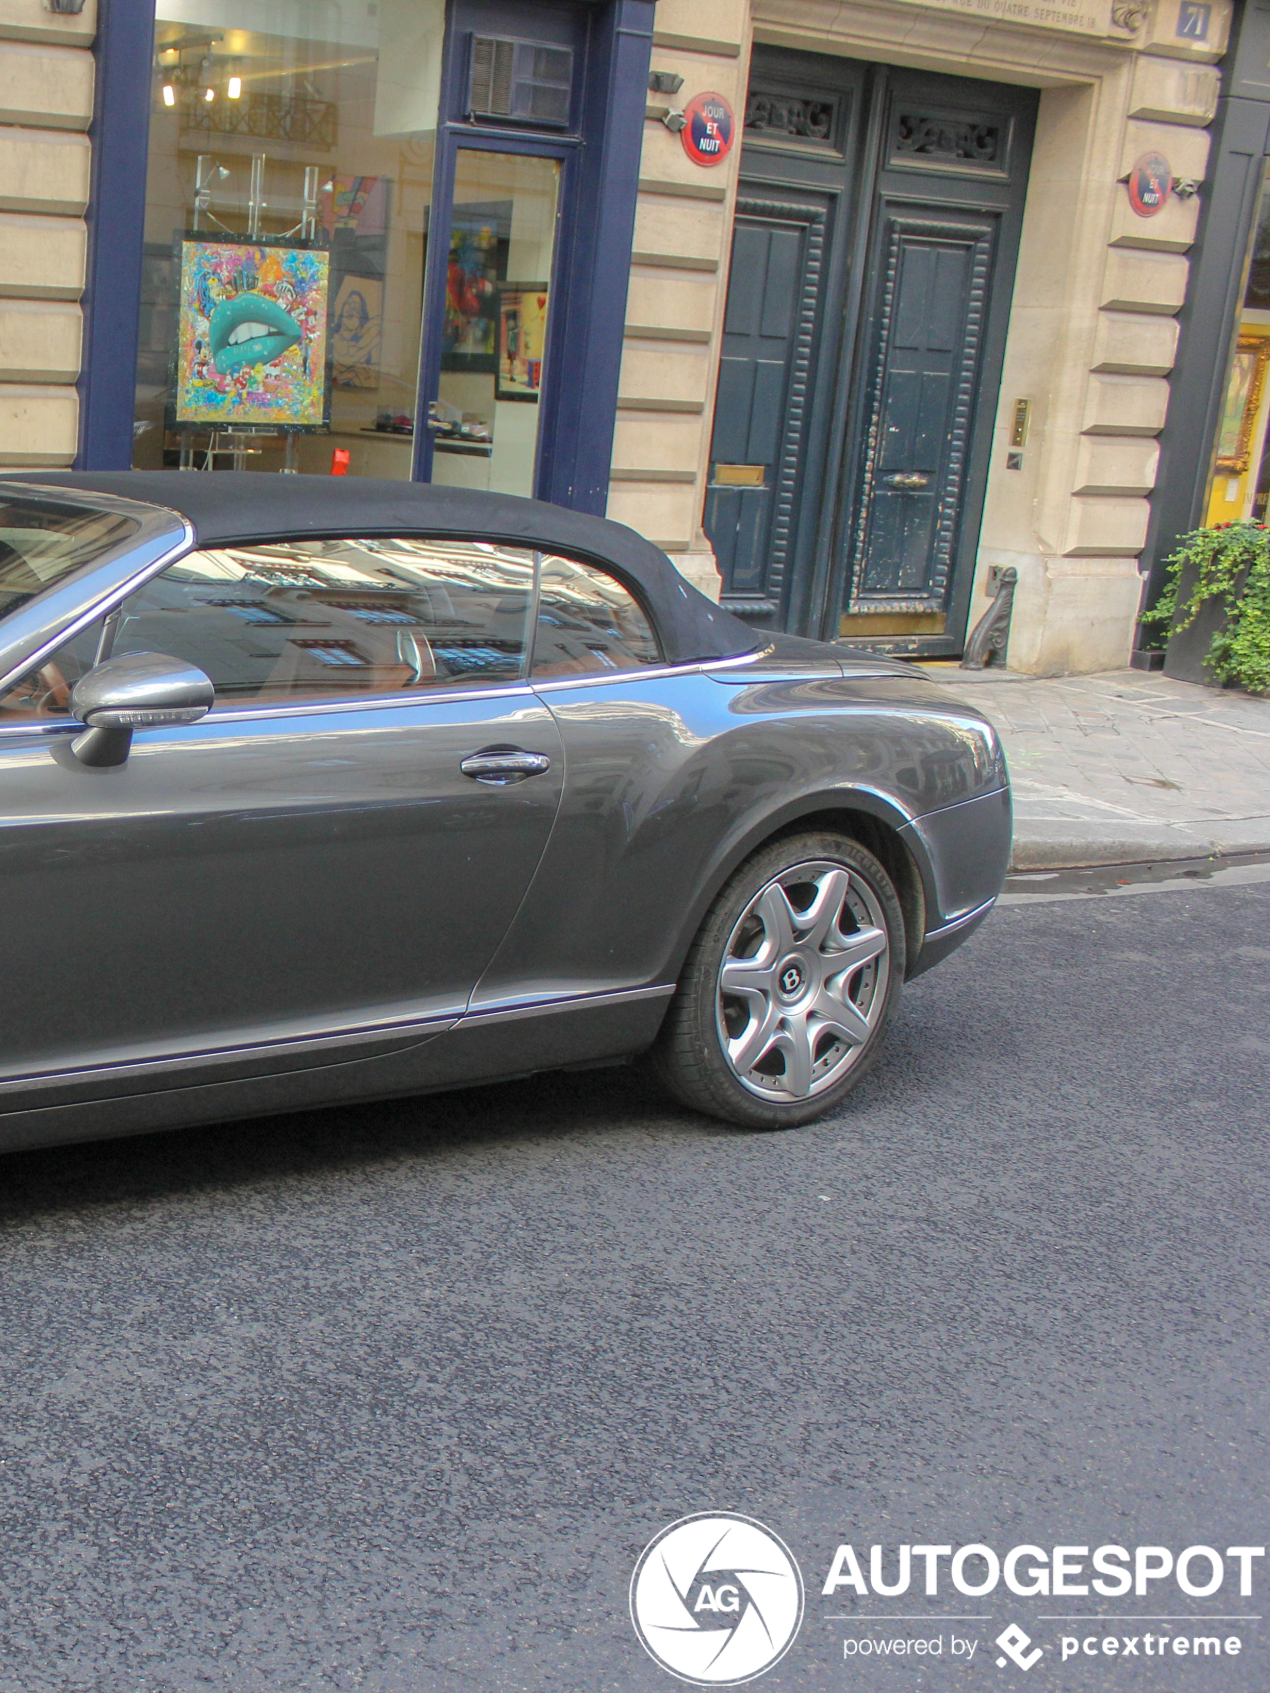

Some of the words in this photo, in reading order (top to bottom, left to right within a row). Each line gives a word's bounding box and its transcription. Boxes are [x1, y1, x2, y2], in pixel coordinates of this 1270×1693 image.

[1034, 8, 1084, 27] SEPTEMBRE
[1183, 6, 1206, 35] 71
[702, 104, 725, 120] JOUR
[706, 122, 718, 135] ET
[698, 137, 721, 152] NUIT
[1149, 178, 1159, 189] ET
[1142, 192, 1159, 204] NUIT
